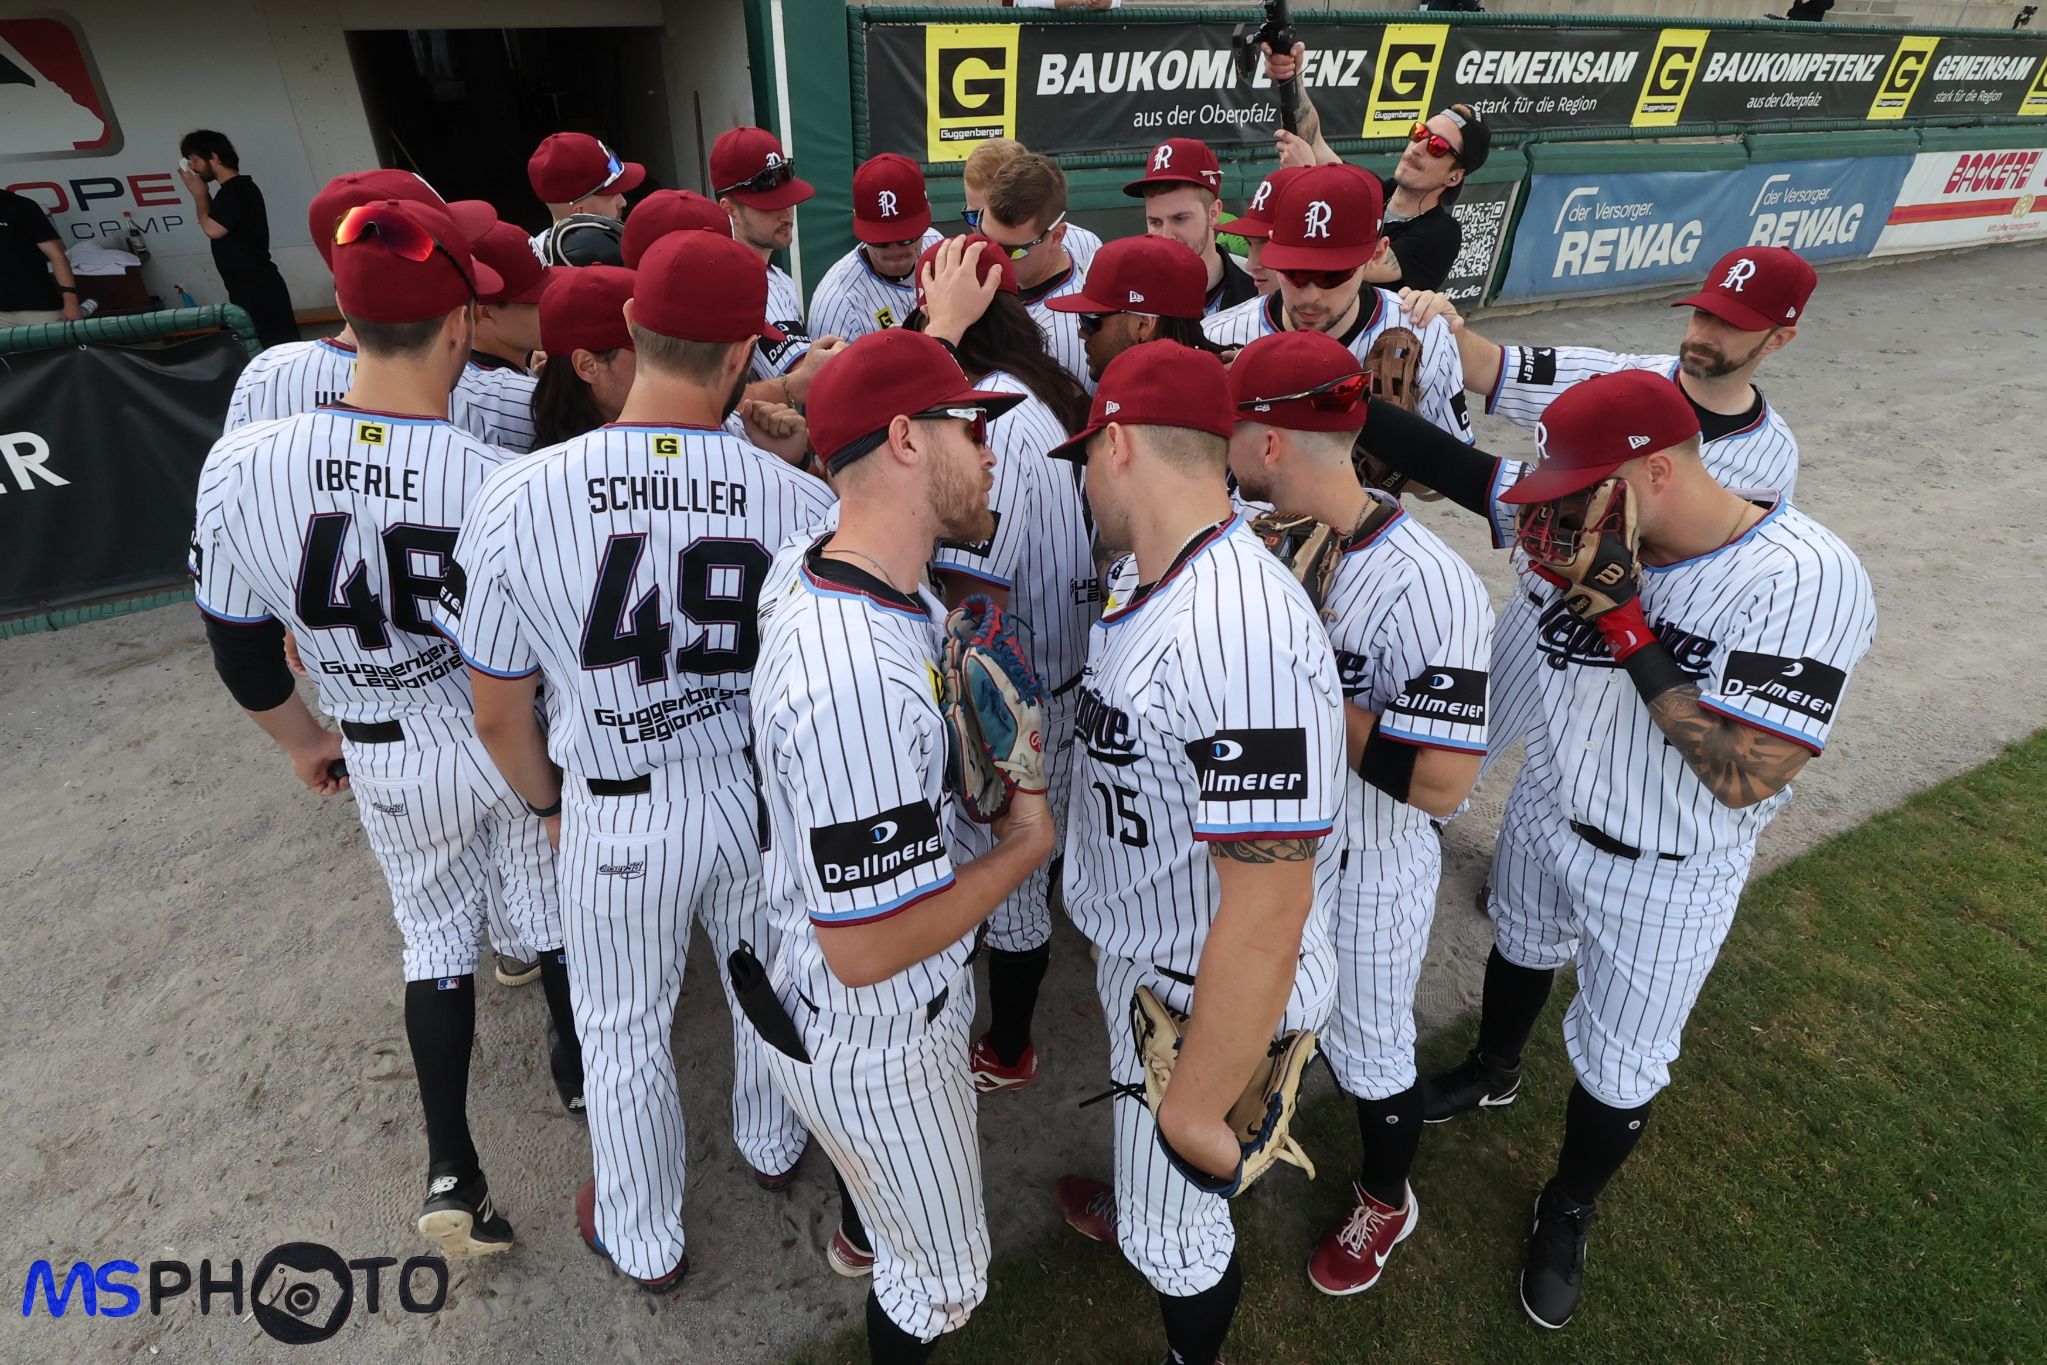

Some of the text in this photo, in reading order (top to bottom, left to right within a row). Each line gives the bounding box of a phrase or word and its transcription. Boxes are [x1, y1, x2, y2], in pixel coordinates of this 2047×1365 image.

[1036, 49, 1368, 96] BAUKOMENZ
[1455, 50, 1639, 85] GEMEINSAM
[1702, 52, 1885, 83] BAUKOMPETENZ
[1933, 55, 2037, 81] GEMEINSAM
[1475, 96, 1597, 115] stark für die Region
[1747, 92, 1822, 110] aus der Oberpfalz
[1979, 89, 2002, 105] Region
[1133, 102, 1277, 127] aus der Oberpfalz
[1374, 109, 1421, 120] Guggenberger
[940, 127, 1004, 140] Guggenberger
[1763, 189, 1783, 205] der
[1304, 200, 1332, 239] R
[1568, 202, 1591, 222] der
[1746, 203, 1865, 249] REWAG
[1552, 219, 1702, 278] REWAG
[1718, 258, 1756, 292] R
[315, 458, 419, 502] IBERLE
[587, 470, 747, 518] SCHÜLLER
[580, 532, 774, 687] 49
[1394, 693, 1484, 719] allmeier
[1201, 769, 1302, 792] llmeier
[1093, 781, 1149, 848] 15
